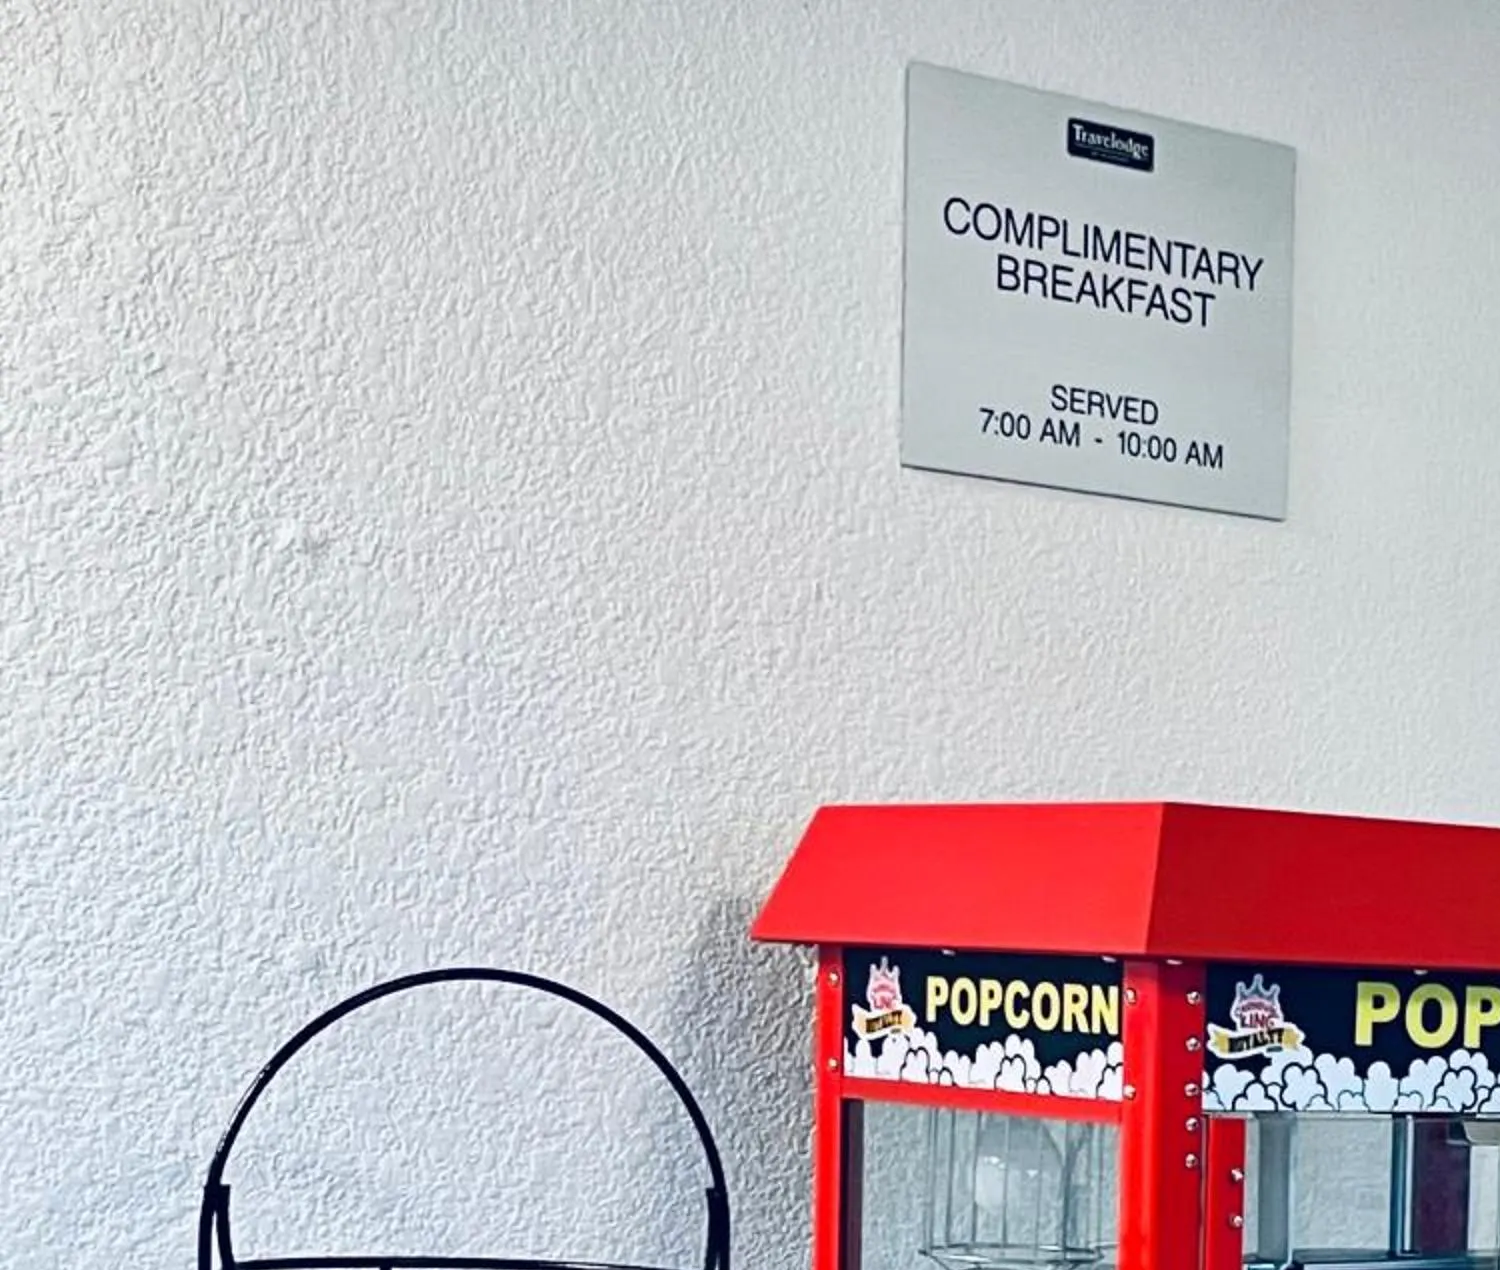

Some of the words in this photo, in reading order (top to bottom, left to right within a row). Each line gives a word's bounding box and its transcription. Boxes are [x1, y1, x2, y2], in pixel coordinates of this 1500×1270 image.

[1072, 123, 1149, 159] Travelodge
[943, 197, 1264, 291] COMPLIMENTARY
[997, 254, 1216, 327] BREAKFAST
[1050, 384, 1159, 425] SERVED
[979, 407, 1031, 440] 7:00
[1040, 419, 1081, 447] AM
[1118, 430, 1177, 463] 10:00
[1185, 441, 1223, 469] AM
[926, 975, 1119, 1035] POPCORN
